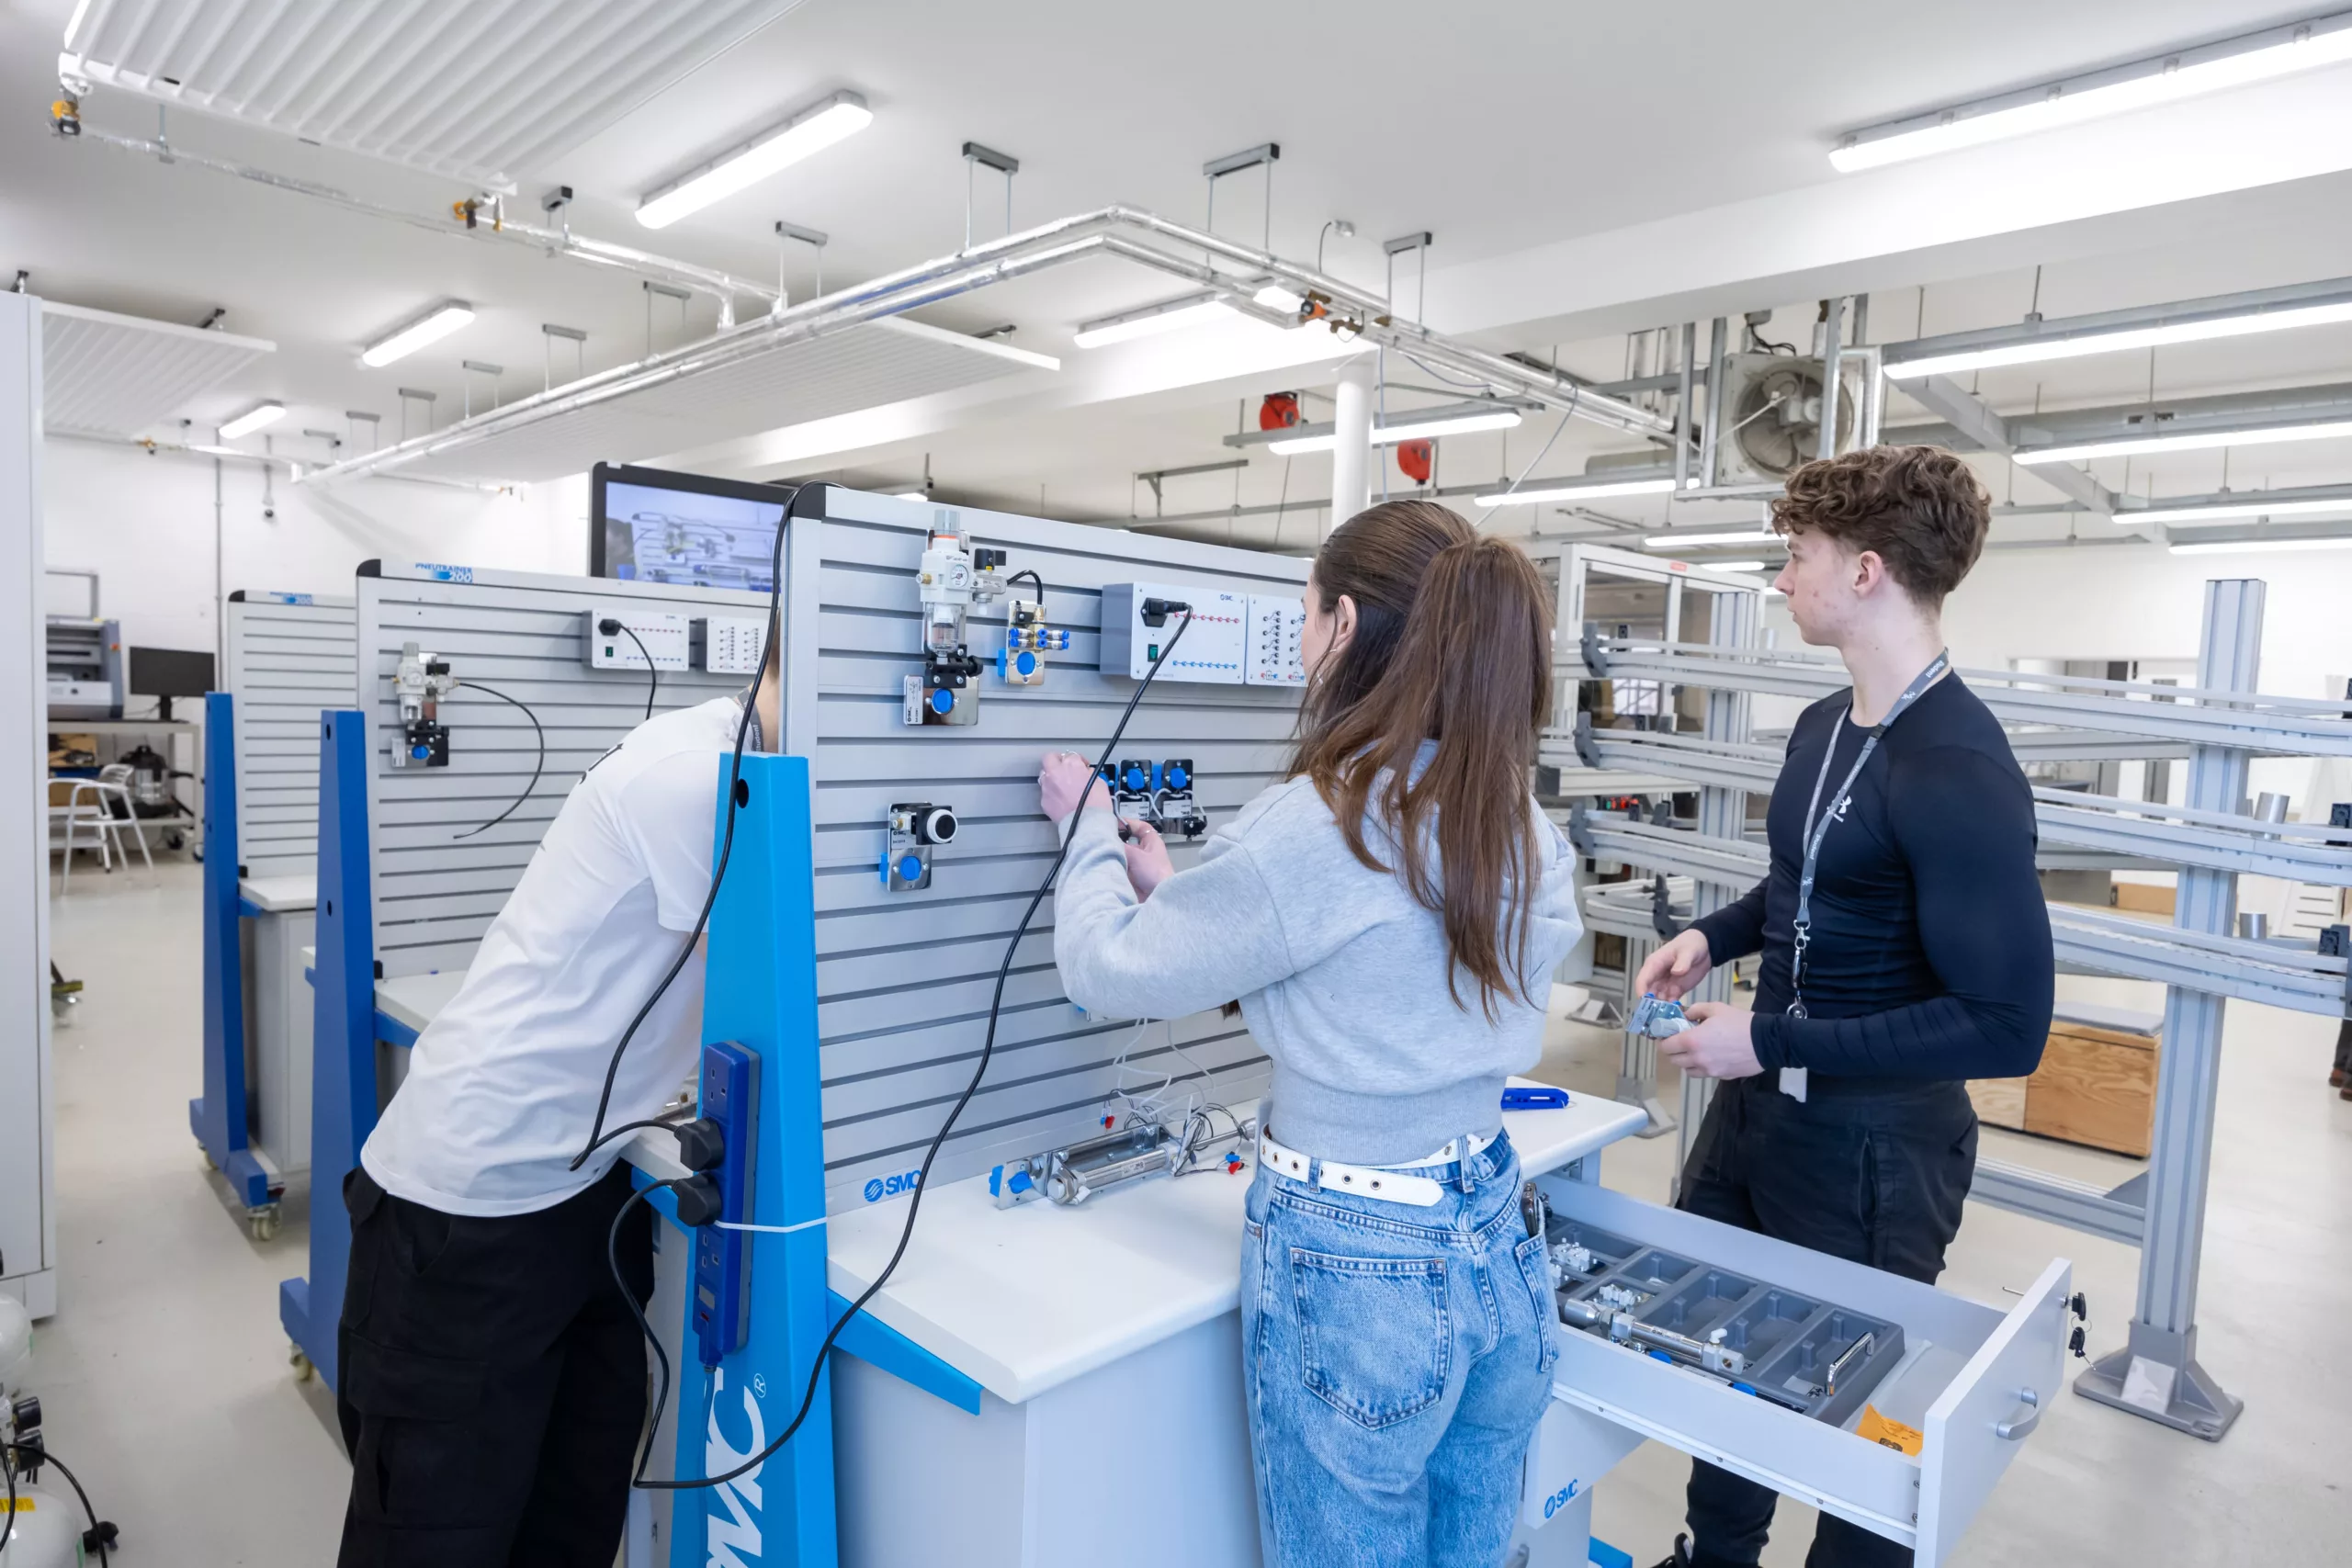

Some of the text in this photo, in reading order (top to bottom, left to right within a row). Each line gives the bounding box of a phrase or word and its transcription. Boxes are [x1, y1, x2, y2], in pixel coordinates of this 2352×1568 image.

[449, 571, 472, 583] 200
[1809, 834, 1821, 861] Student
[885, 1169, 922, 1196] SMC
[706, 1366, 765, 1568] MC
[1556, 1478, 1577, 1508] SMC
